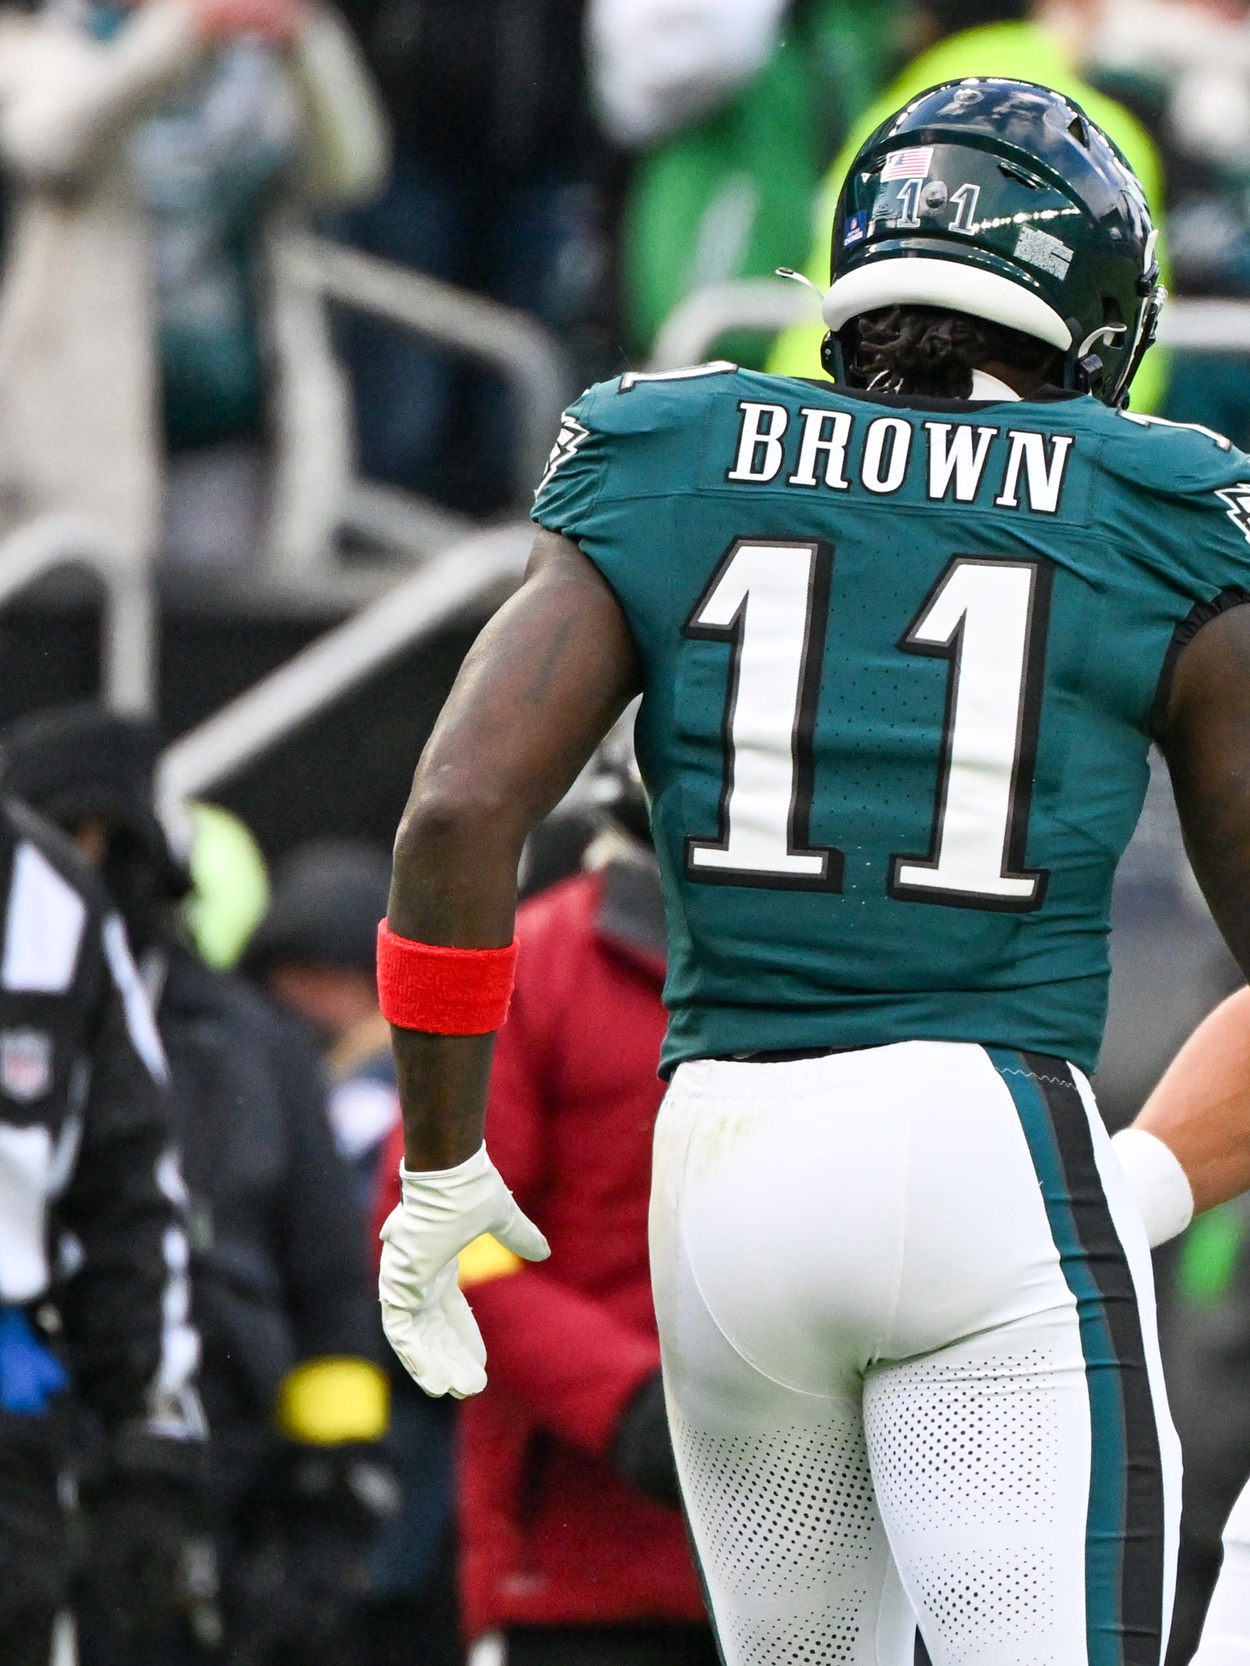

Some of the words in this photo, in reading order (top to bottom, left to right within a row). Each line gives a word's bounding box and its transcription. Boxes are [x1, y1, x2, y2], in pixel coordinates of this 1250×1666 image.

[896, 178, 980, 236] 11
[726, 400, 1075, 516] BROWN
[683, 537, 1048, 911] 11
